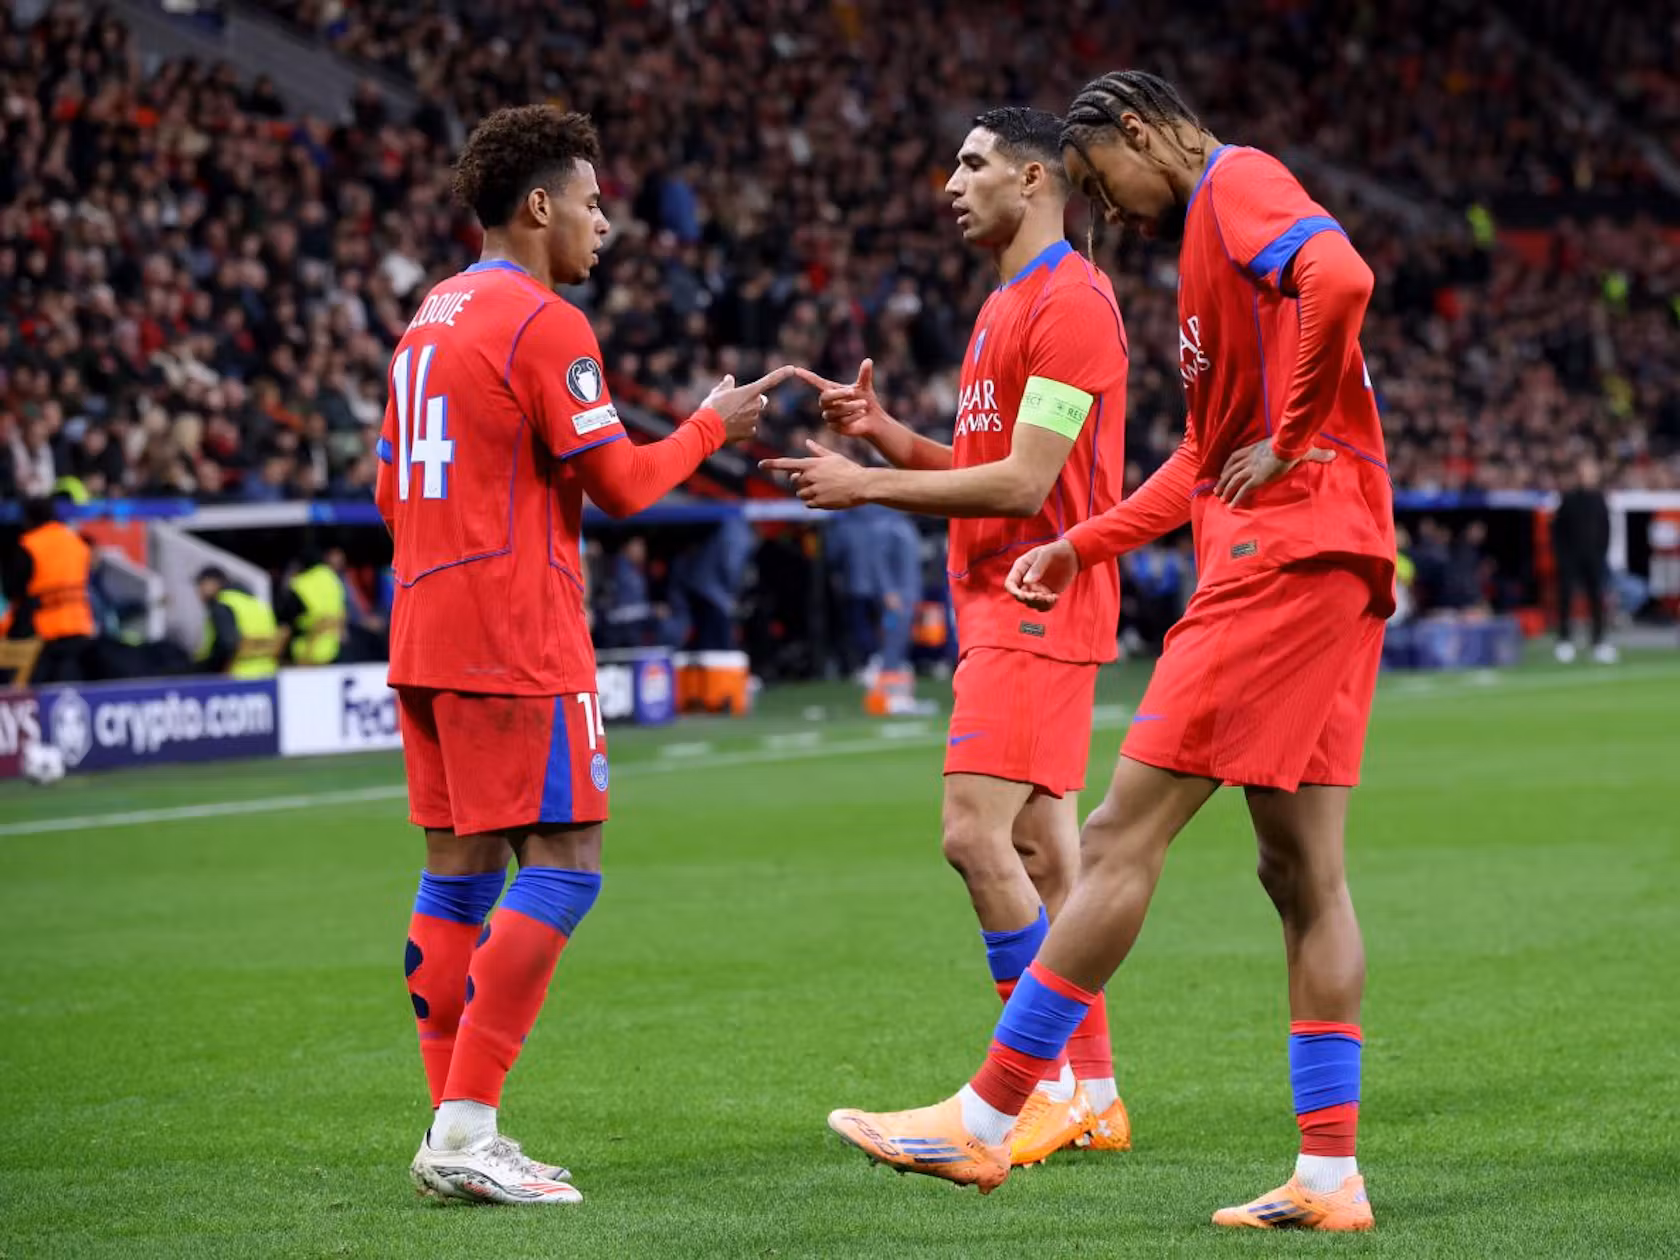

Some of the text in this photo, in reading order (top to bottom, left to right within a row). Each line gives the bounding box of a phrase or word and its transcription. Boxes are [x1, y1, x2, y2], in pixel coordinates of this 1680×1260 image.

[410, 289, 475, 328] .DOUÉ
[392, 345, 456, 503] 14
[1066, 407, 1085, 422] RES
[94, 691, 273, 754] crypto.com
[342, 676, 400, 738] Fed
